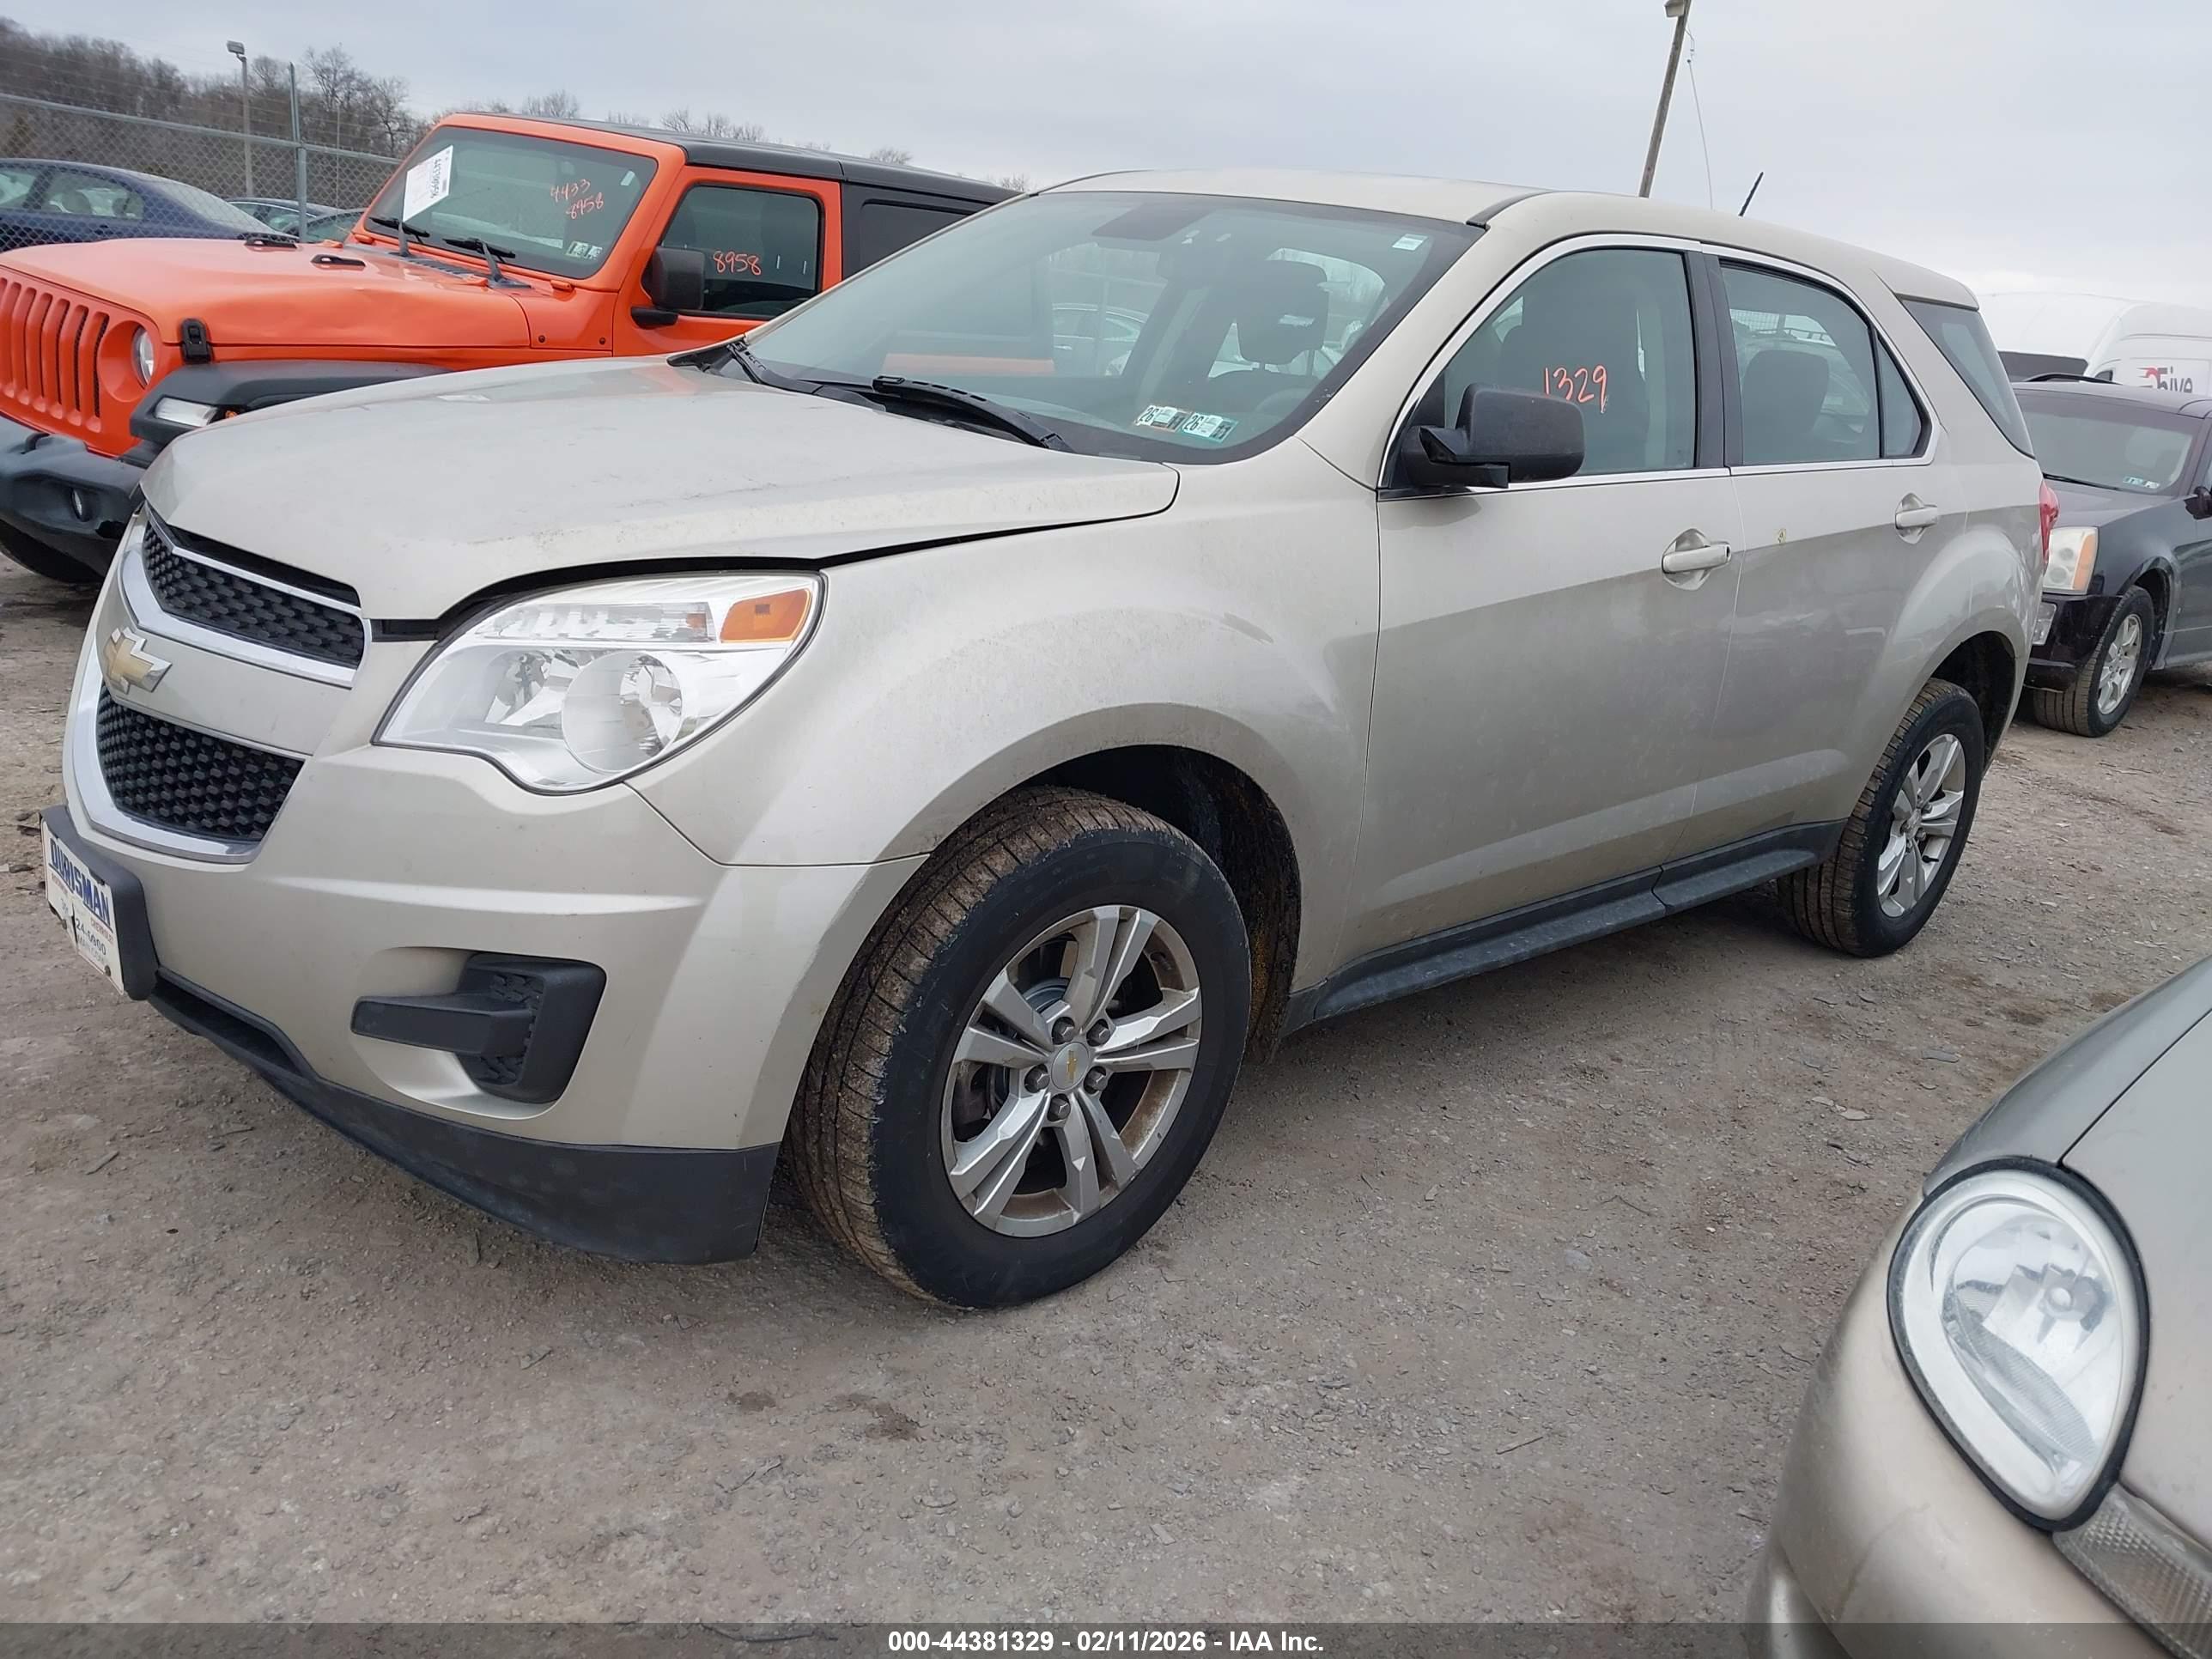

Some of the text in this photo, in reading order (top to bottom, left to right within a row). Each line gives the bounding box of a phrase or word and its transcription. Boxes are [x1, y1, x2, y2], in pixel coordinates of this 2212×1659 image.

[550, 179, 590, 203] 4433
[565, 191, 604, 219] 8958
[713, 251, 761, 276] 8958
[1545, 365, 1607, 413] 1329
[1139, 406, 1159, 422] 26
[1184, 415, 1204, 431] 26
